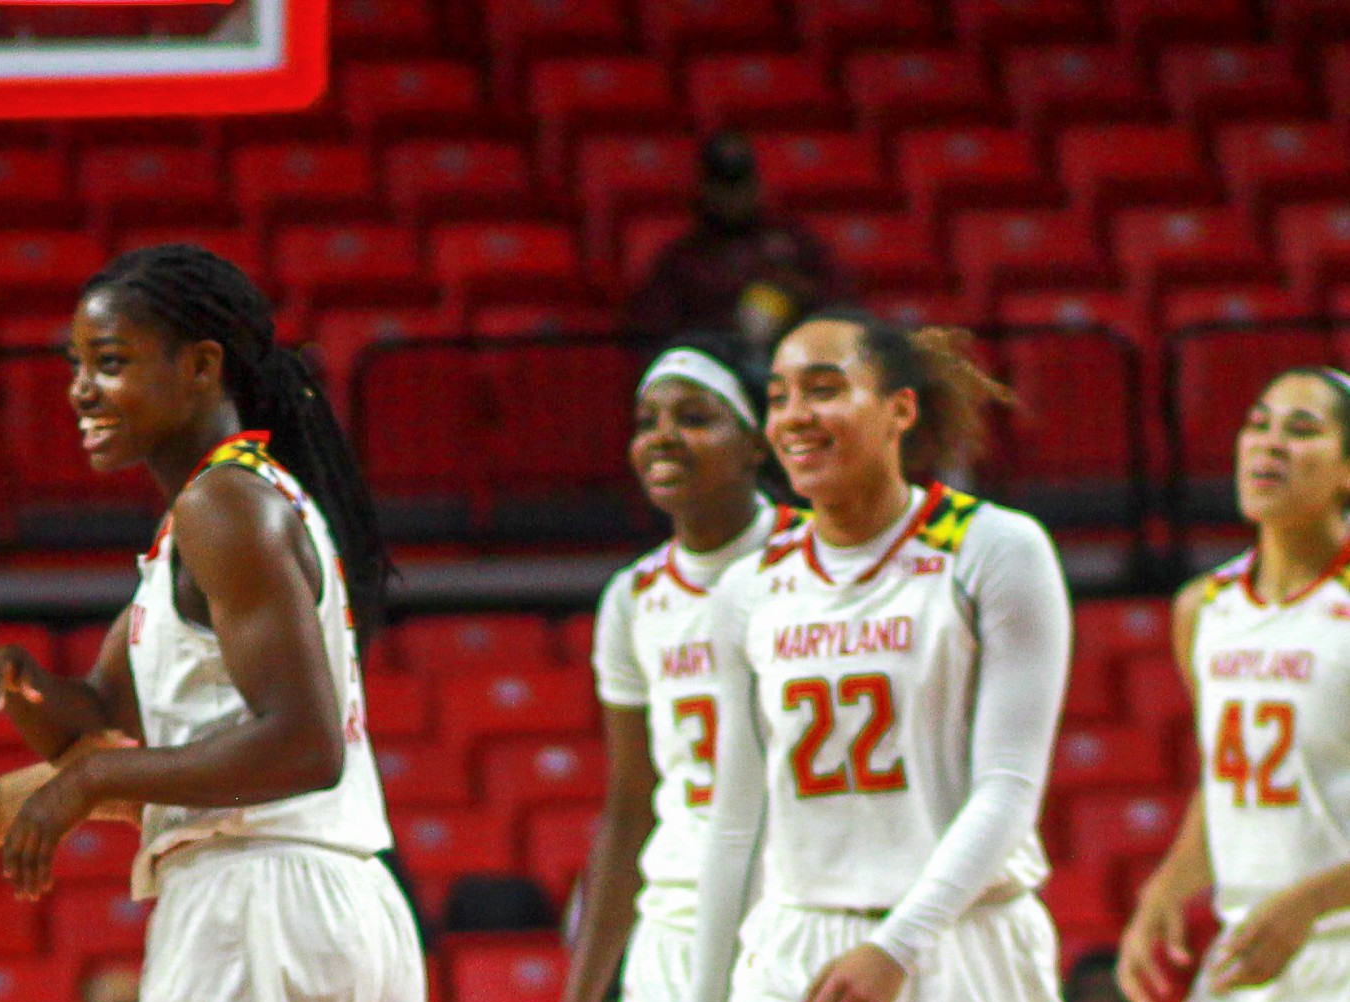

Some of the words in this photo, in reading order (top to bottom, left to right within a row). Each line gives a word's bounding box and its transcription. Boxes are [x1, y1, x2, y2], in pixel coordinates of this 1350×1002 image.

[772, 616, 913, 664] MARYLAND
[782, 672, 910, 799] 22
[1213, 699, 1302, 809] 42
